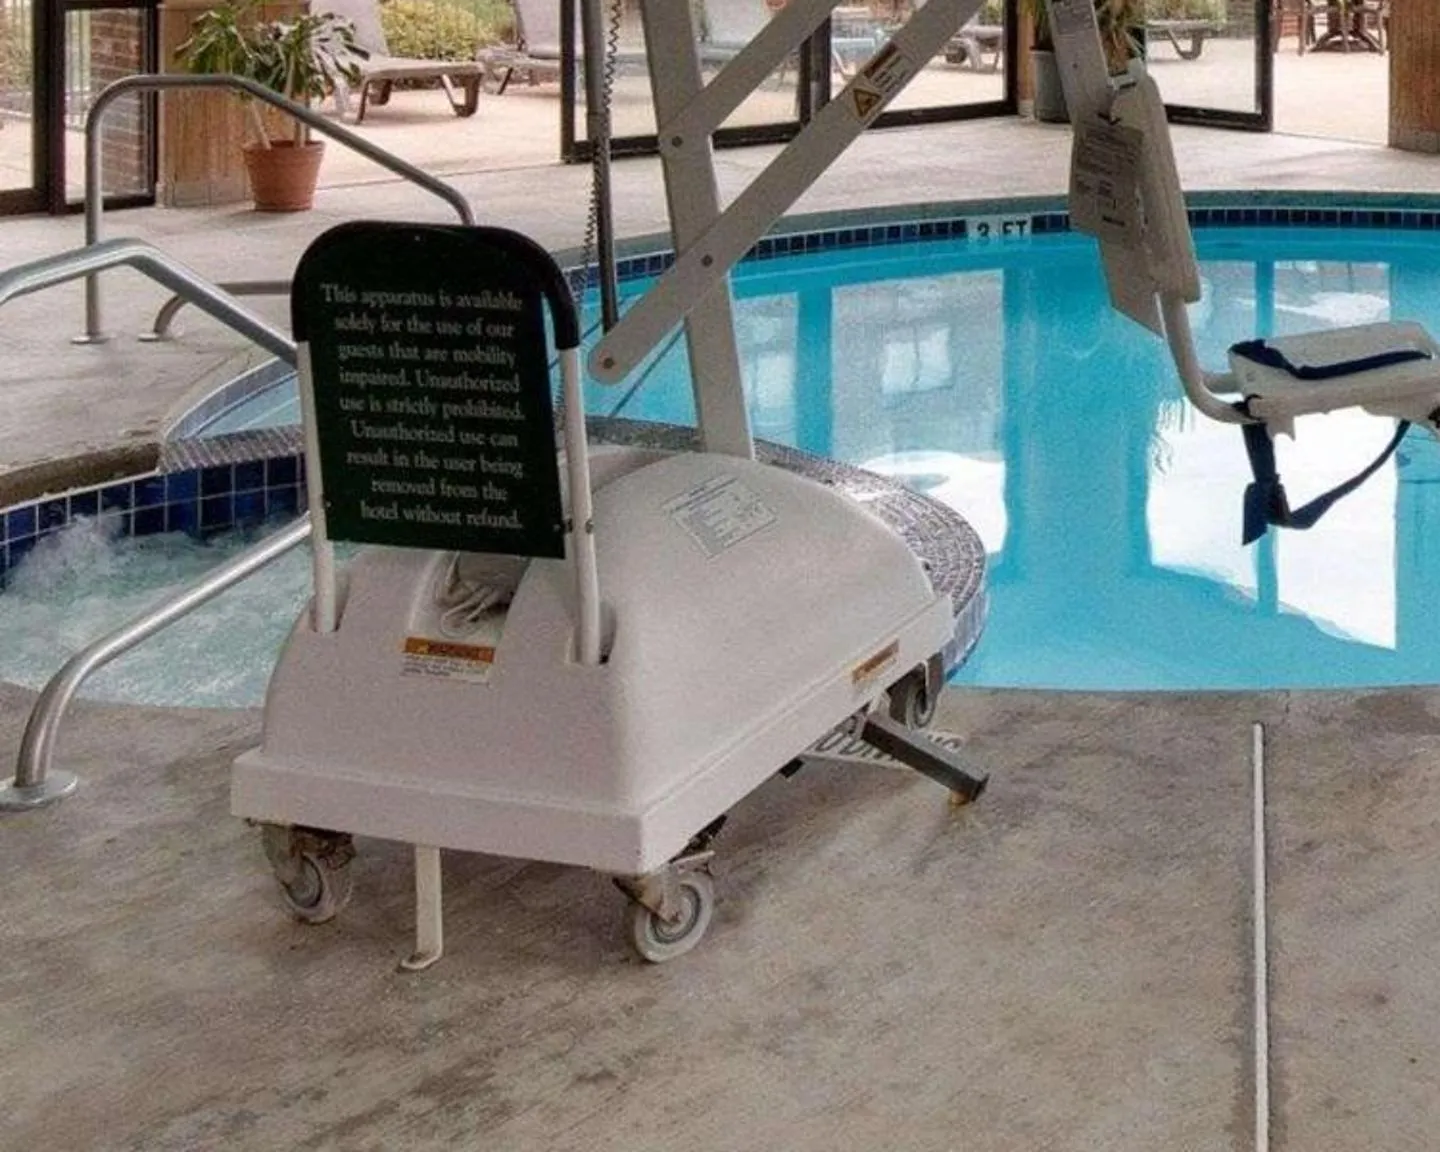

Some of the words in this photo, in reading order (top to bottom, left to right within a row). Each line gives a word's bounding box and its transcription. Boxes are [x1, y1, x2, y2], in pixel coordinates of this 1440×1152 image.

[318, 281, 358, 304] This
[359, 289, 436, 309] apparatus
[437, 288, 453, 309] is
[455, 289, 524, 312] available
[333, 311, 376, 334] solely
[379, 313, 404, 334] for
[405, 314, 434, 335] the
[435, 321, 463, 336] use
[465, 317, 484, 336] of
[484, 322, 516, 339] our
[337, 343, 385, 362] guests
[388, 340, 421, 361] that
[423, 348, 449, 363] are
[451, 345, 517, 369] mobility
[338, 366, 412, 390] impaired.
[414, 368, 521, 394] Unauthorized
[339, 396, 365, 412] use
[368, 394, 383, 413] is
[384, 394, 439, 418] strictly
[441, 398, 527, 421] prohibited.
[350, 419, 456, 445] Unauthorized
[458, 431, 486, 446] use
[489, 433, 519, 448] can
[345, 447, 390, 467] result
[392, 449, 410, 468] in
[413, 449, 441, 470] the
[442, 457, 477, 471] user
[478, 453, 524, 481] being
[371, 477, 436, 496] removed
[439, 478, 478, 499] from
[481, 480, 509, 502] the
[359, 499, 399, 521] hotel
[402, 503, 463, 526] without
[466, 507, 524, 530] refund.
